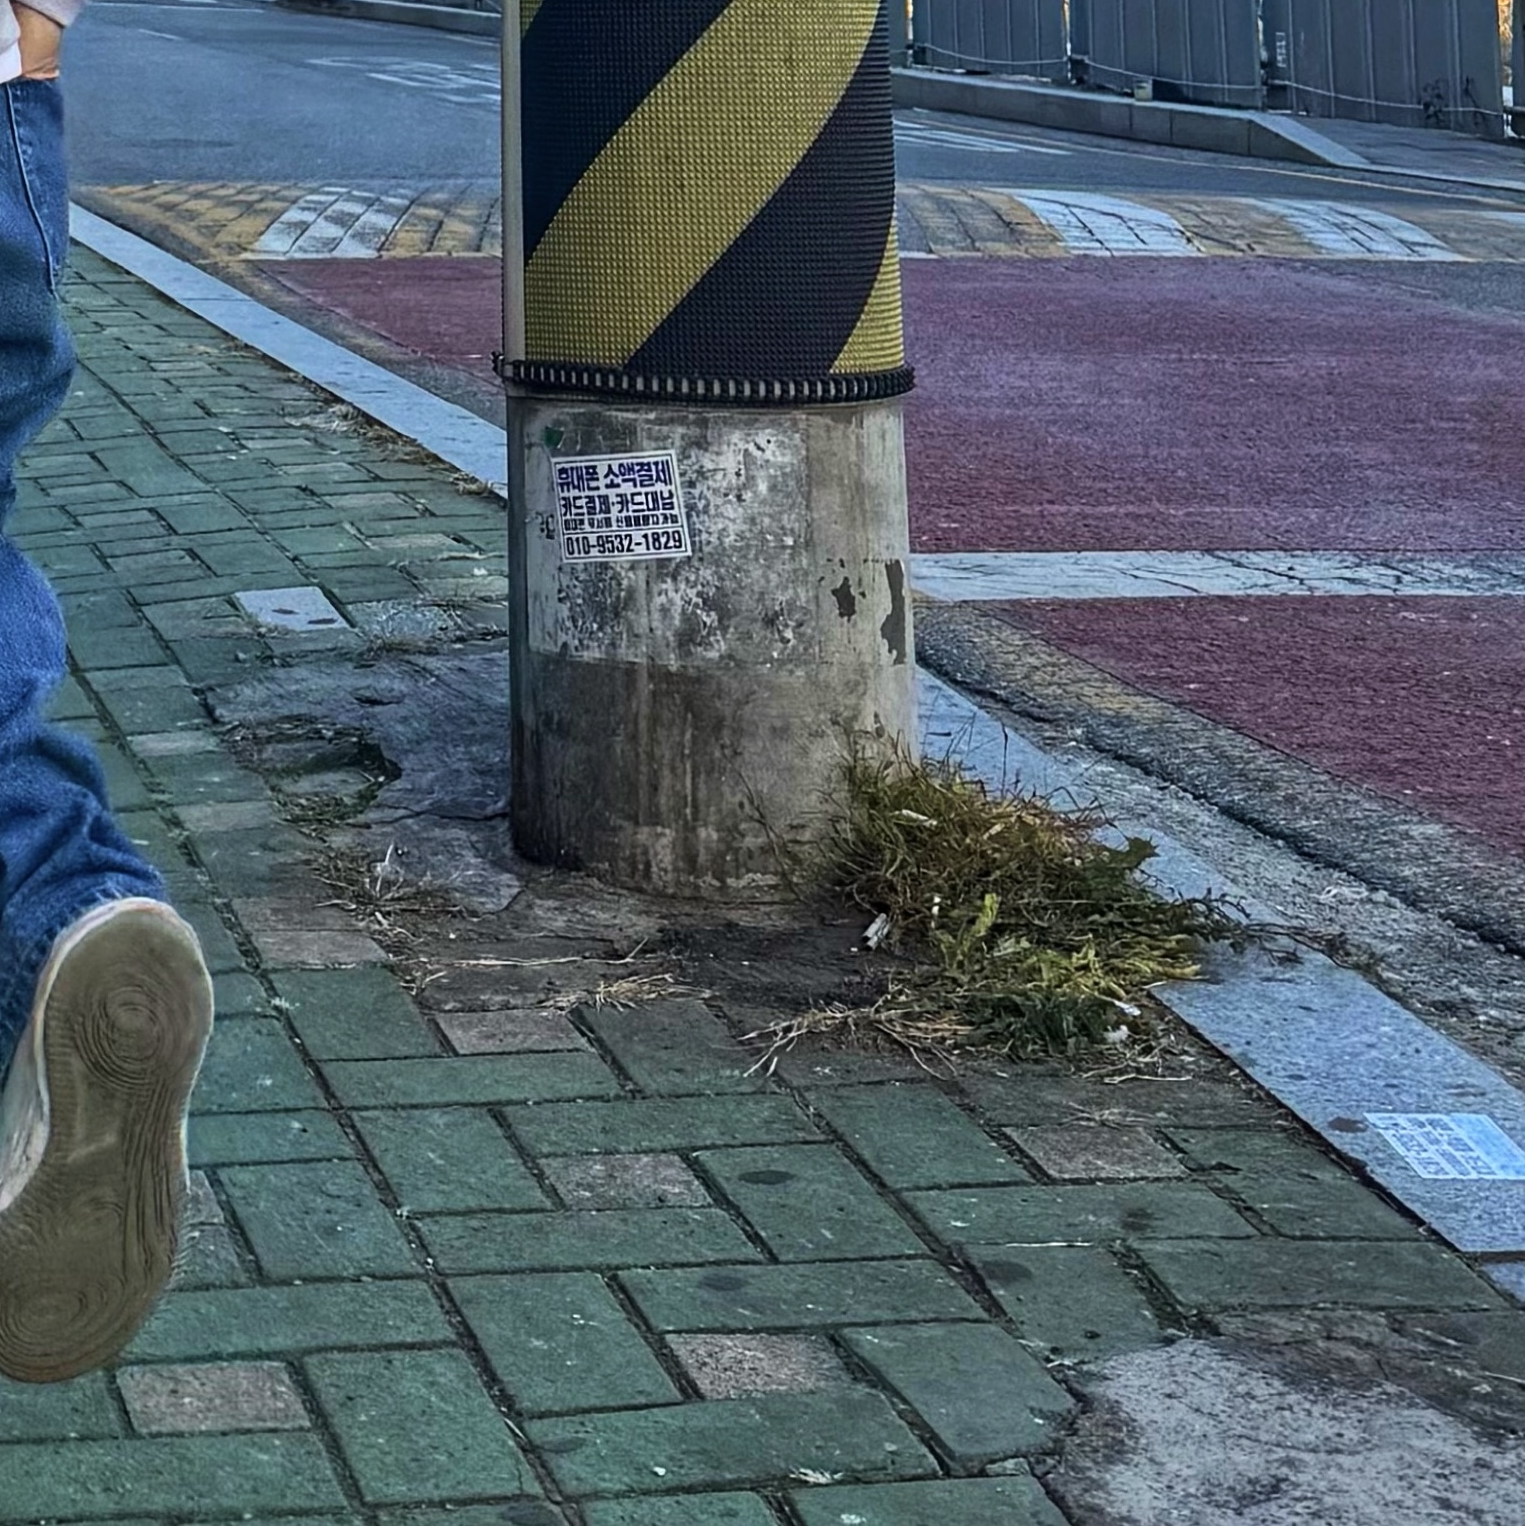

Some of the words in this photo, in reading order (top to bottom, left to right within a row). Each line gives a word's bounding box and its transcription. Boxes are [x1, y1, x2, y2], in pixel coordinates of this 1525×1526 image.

[557, 465, 601, 493] 휴대폰
[603, 459, 673, 490] 소액결제
[565, 531, 682, 555] 010-9532-1829
